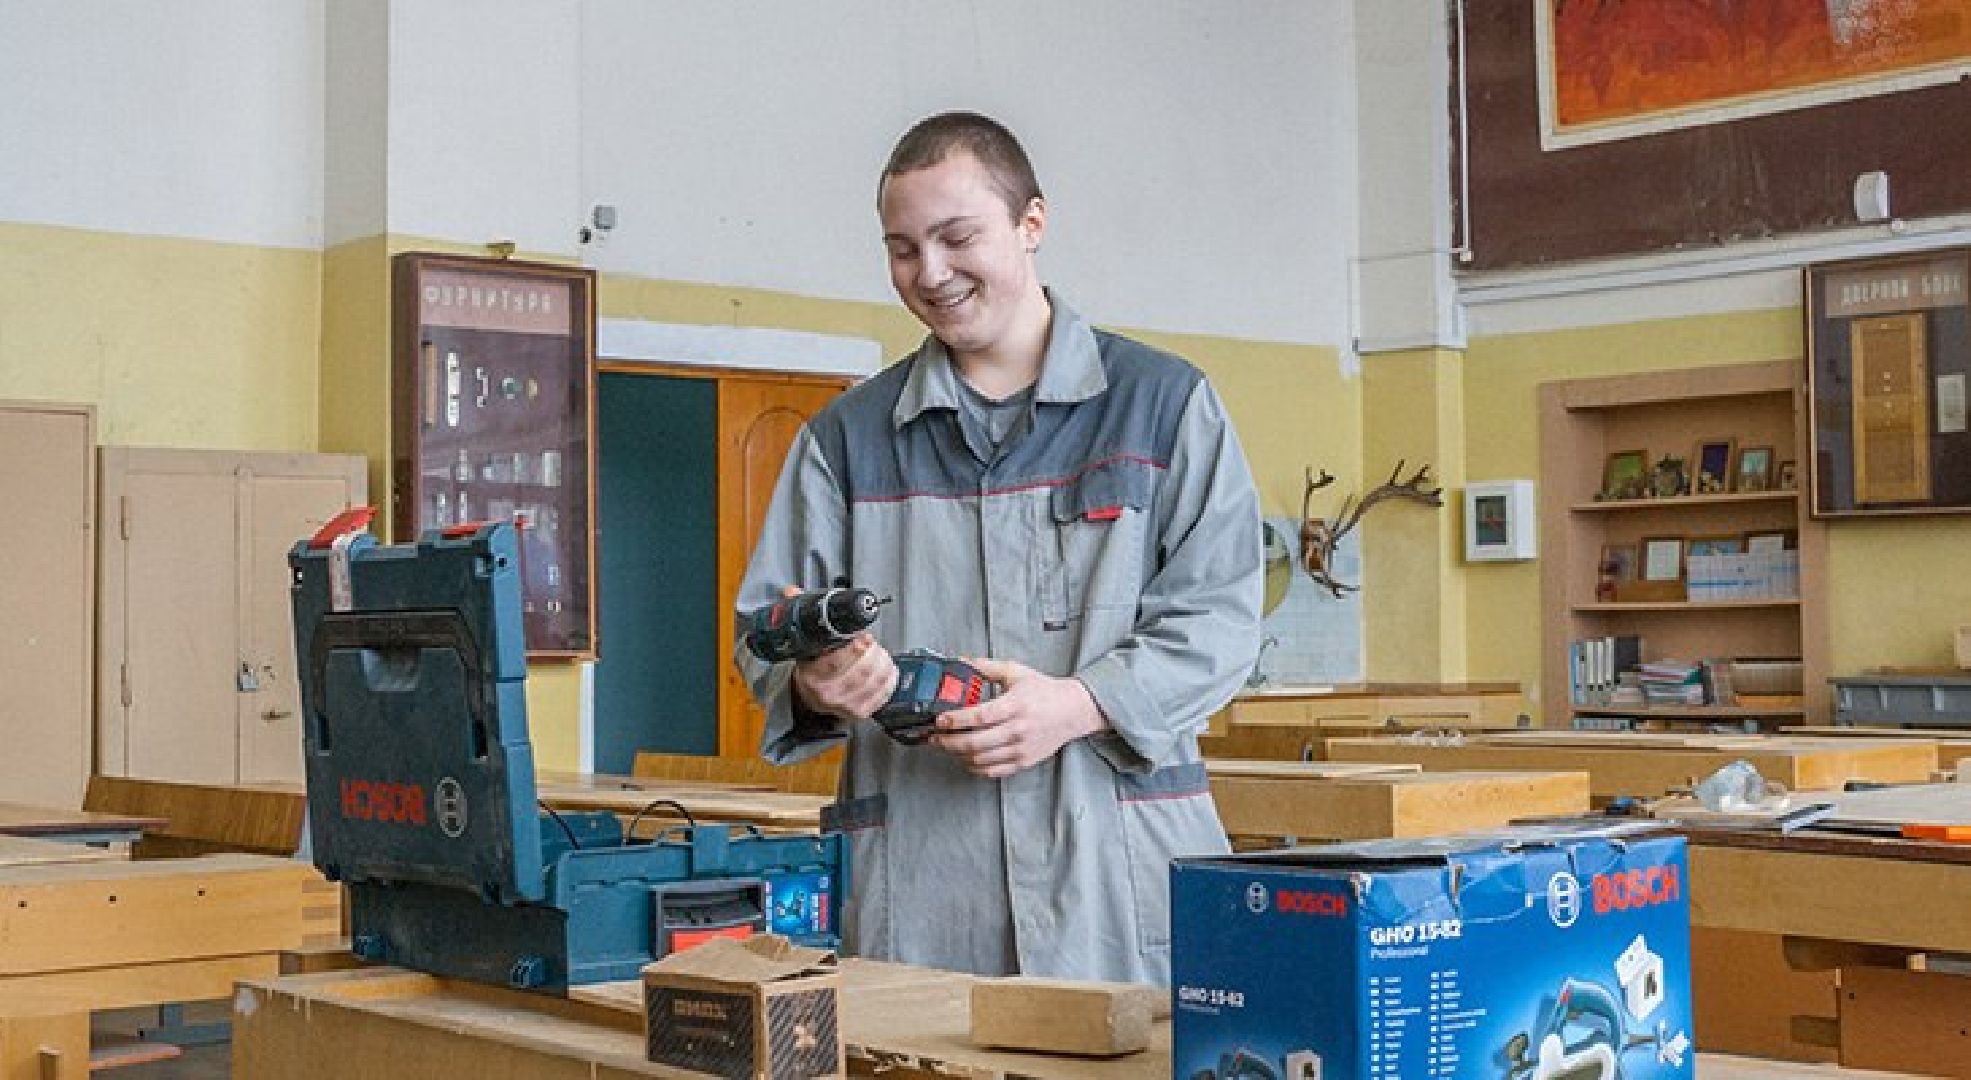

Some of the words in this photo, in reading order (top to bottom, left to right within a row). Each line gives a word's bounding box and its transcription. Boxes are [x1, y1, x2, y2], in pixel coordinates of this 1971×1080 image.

[339, 778, 428, 824] BOSCH
[1276, 891, 1347, 917] BOSCH
[1594, 864, 1679, 913] BOSCH
[1370, 926, 1415, 945] GHO
